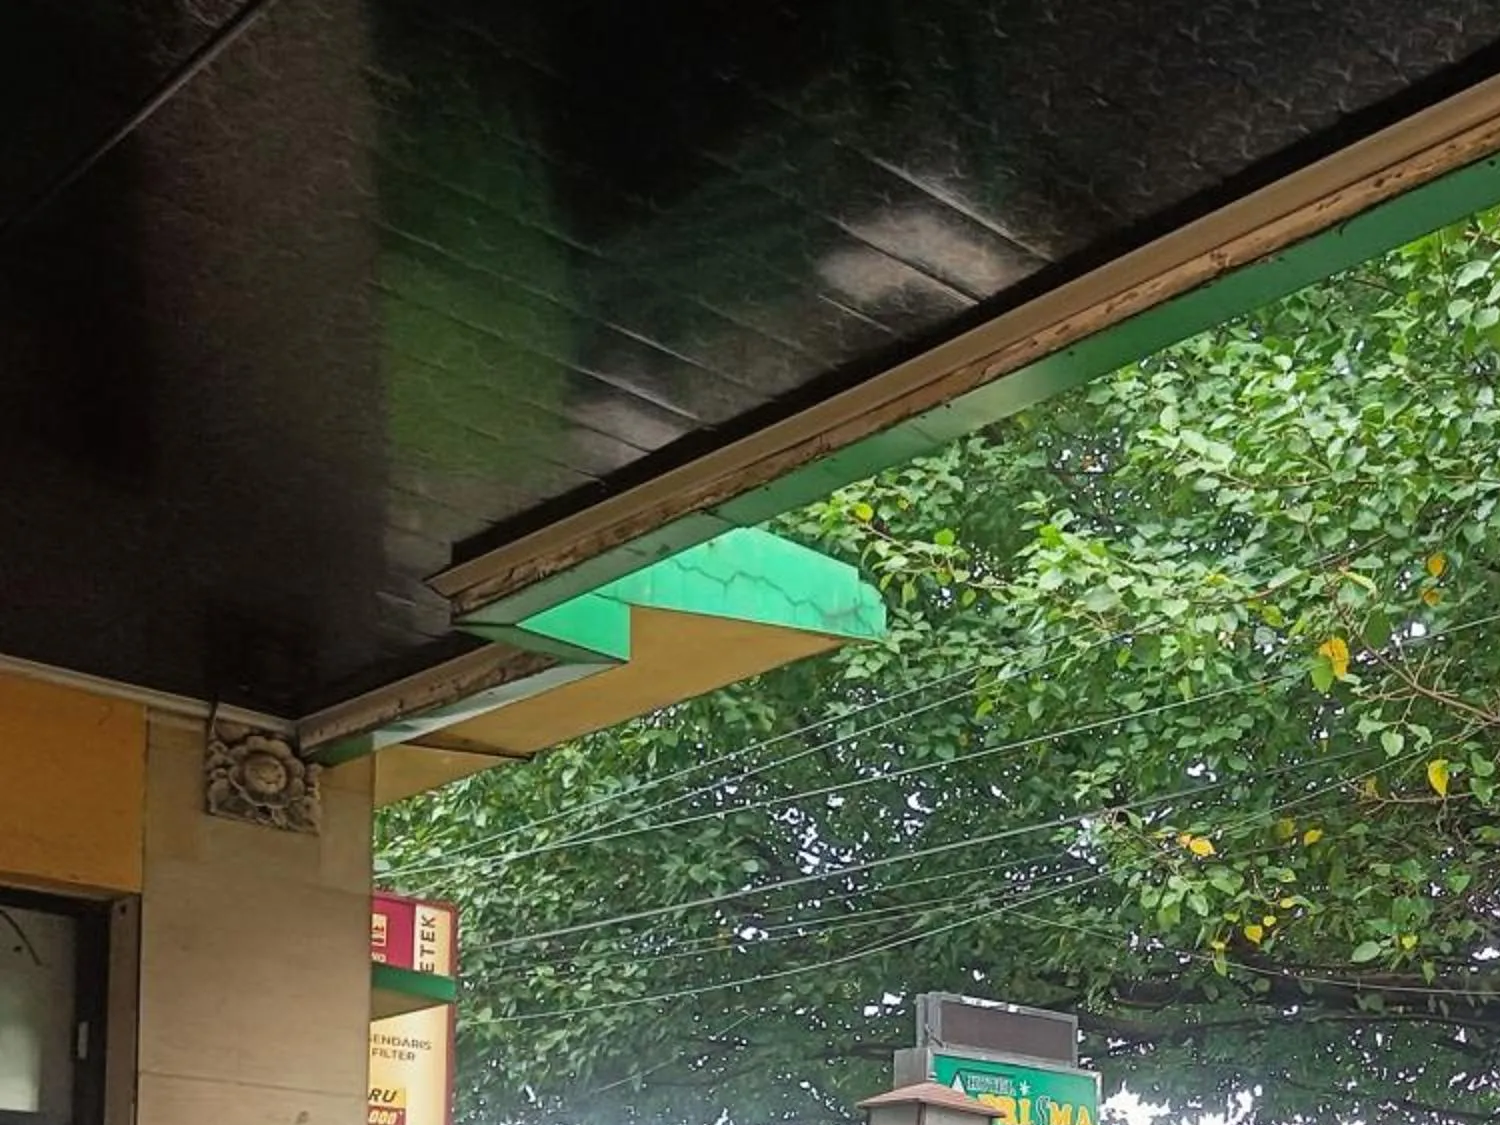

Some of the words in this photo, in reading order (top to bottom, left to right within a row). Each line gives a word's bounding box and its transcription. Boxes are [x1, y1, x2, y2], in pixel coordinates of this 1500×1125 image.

[368, 1033, 432, 1051] ENDARIS
[371, 1047, 416, 1061] FILTER
[368, 1088, 397, 1103] RU
